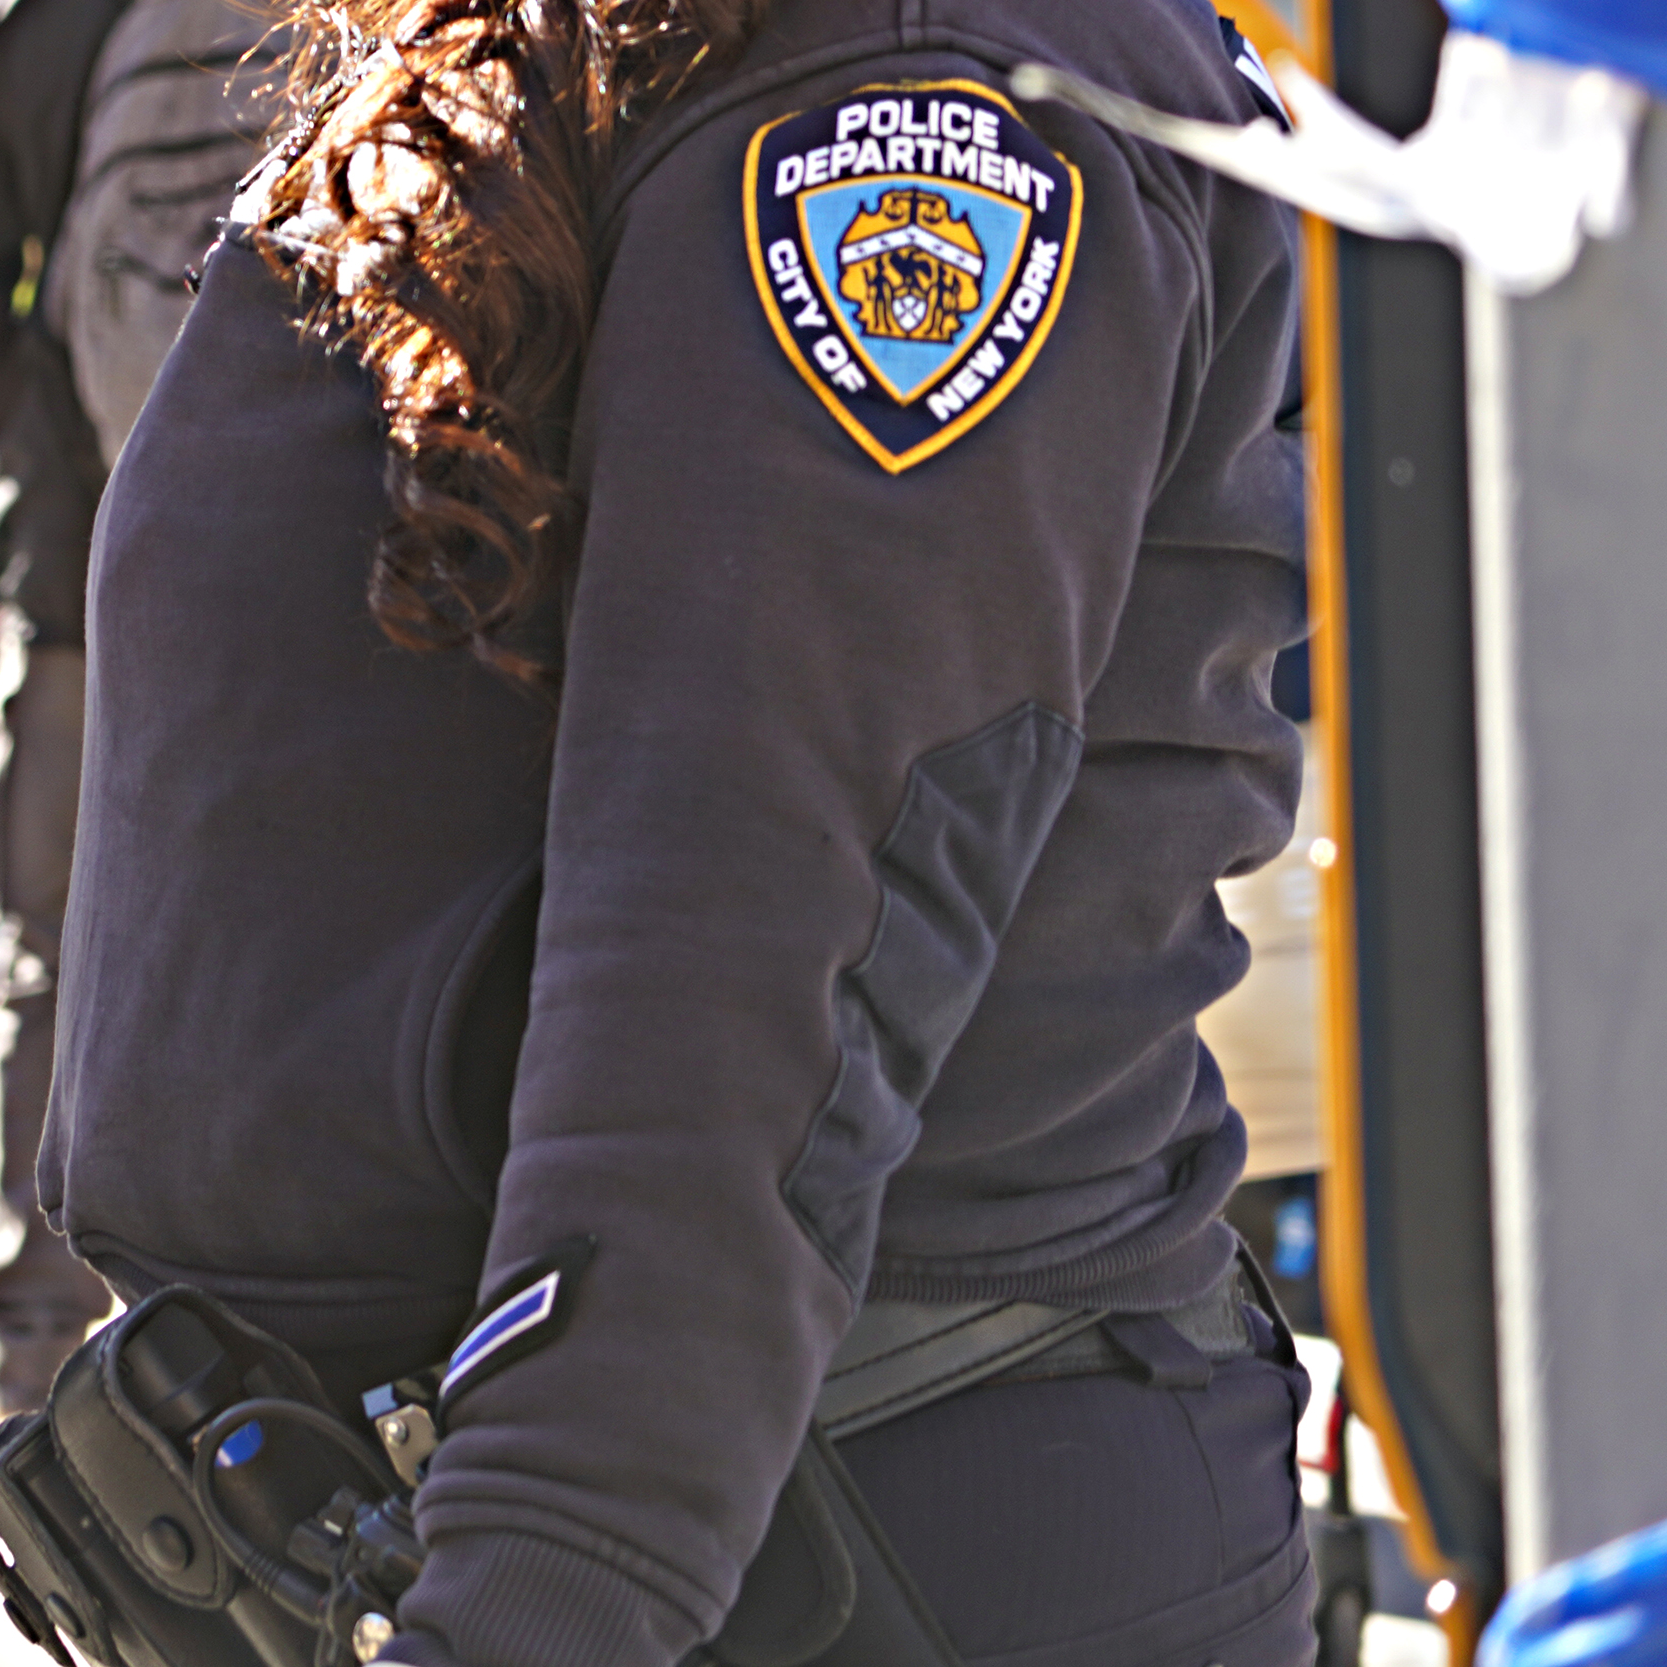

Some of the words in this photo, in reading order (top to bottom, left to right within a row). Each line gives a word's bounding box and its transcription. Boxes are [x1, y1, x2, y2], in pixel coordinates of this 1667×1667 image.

[775, 136, 1055, 213] DEPARTMENT
[835, 98, 1000, 152] POLICE
[768, 237, 828, 329] CITY
[812, 334, 867, 393] OF
[925, 338, 1005, 422] NEW
[992, 236, 1060, 343] YORK
